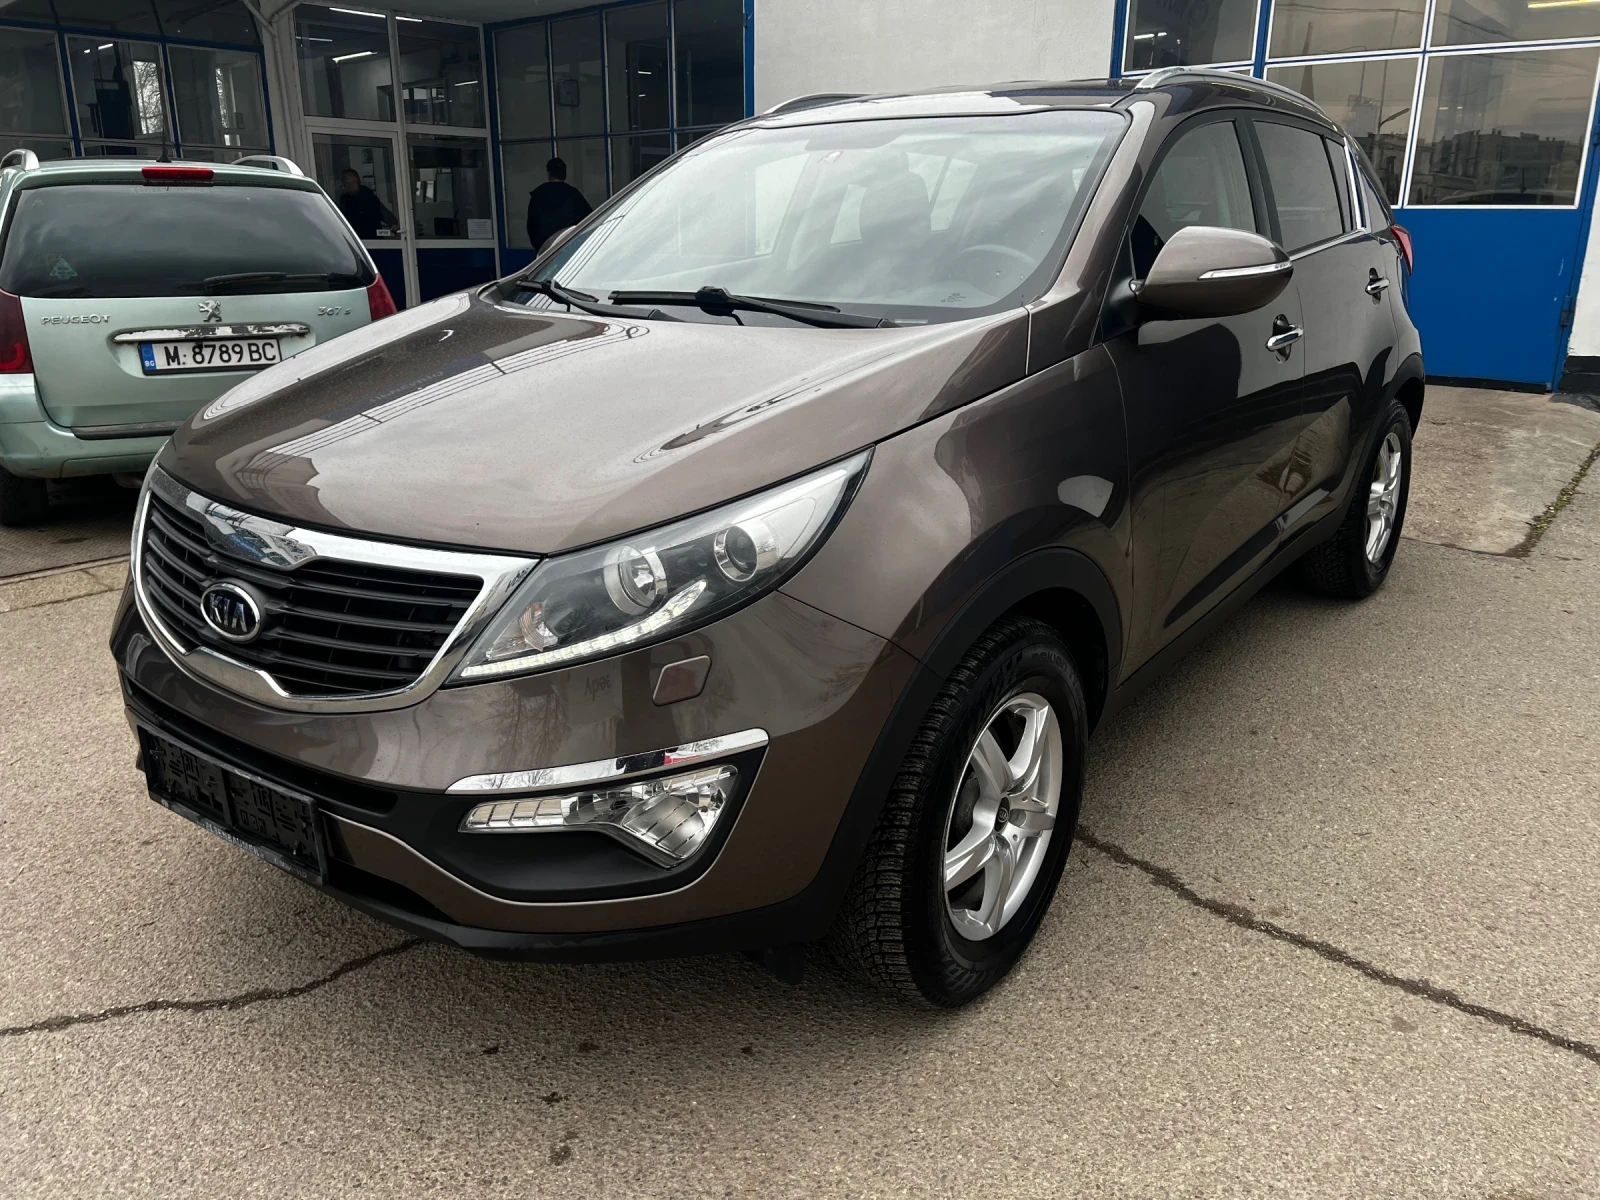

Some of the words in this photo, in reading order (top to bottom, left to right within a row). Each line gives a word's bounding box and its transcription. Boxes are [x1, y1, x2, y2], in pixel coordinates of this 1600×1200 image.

[40, 313, 111, 325] PEUGEOT
[317, 306, 342, 316] 307
[192, 343, 244, 364] 8789
[248, 342, 277, 362] BC
[209, 592, 248, 632] KIA
